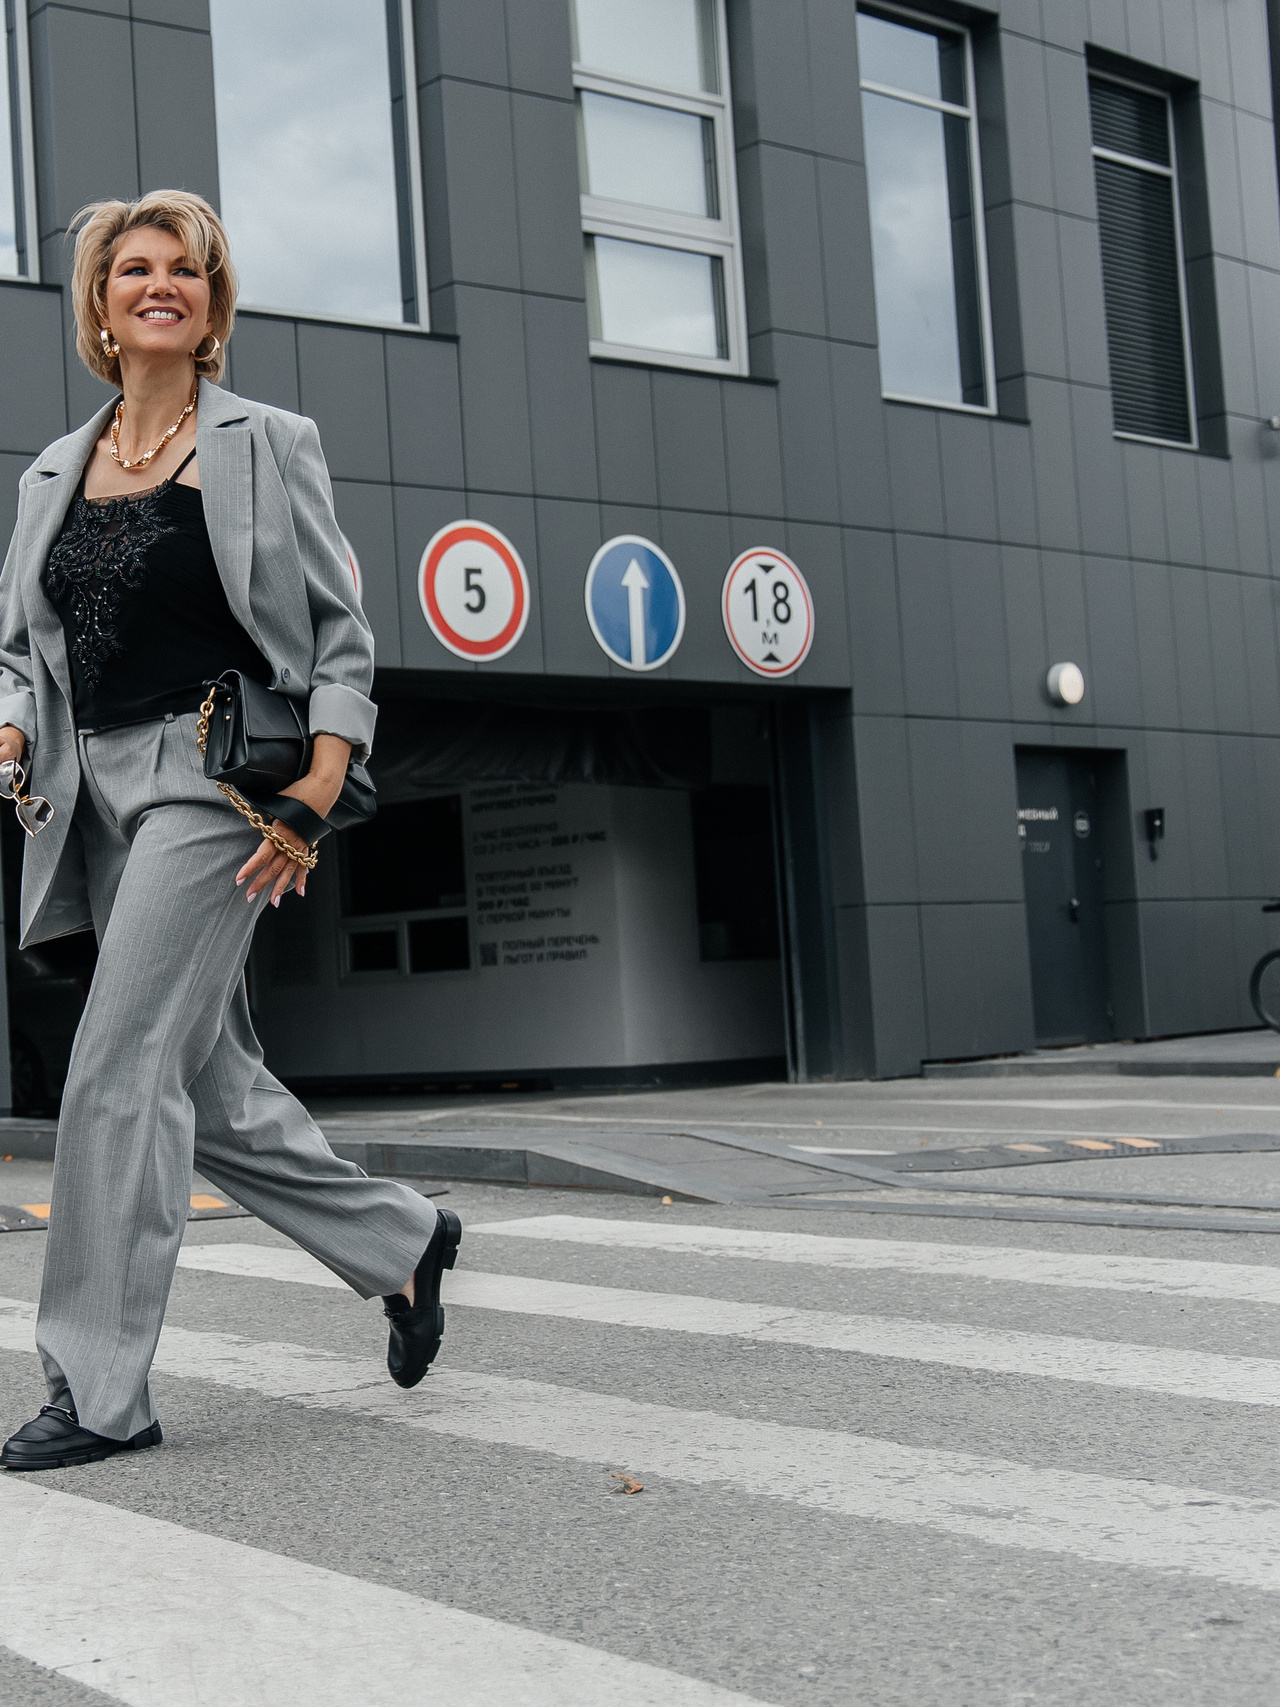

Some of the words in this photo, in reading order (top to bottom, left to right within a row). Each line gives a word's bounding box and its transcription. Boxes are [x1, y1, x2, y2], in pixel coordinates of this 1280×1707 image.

[464, 568, 486, 614] 5
[502, 936, 545, 950] ПОЛНЫЙ
[547, 934, 599, 947] ПЕРЕЧЕНЬ
[503, 953, 533, 966] ЛЬГОТ
[536, 952, 544, 963] И
[546, 948, 587, 962] ПРАВИЛ
